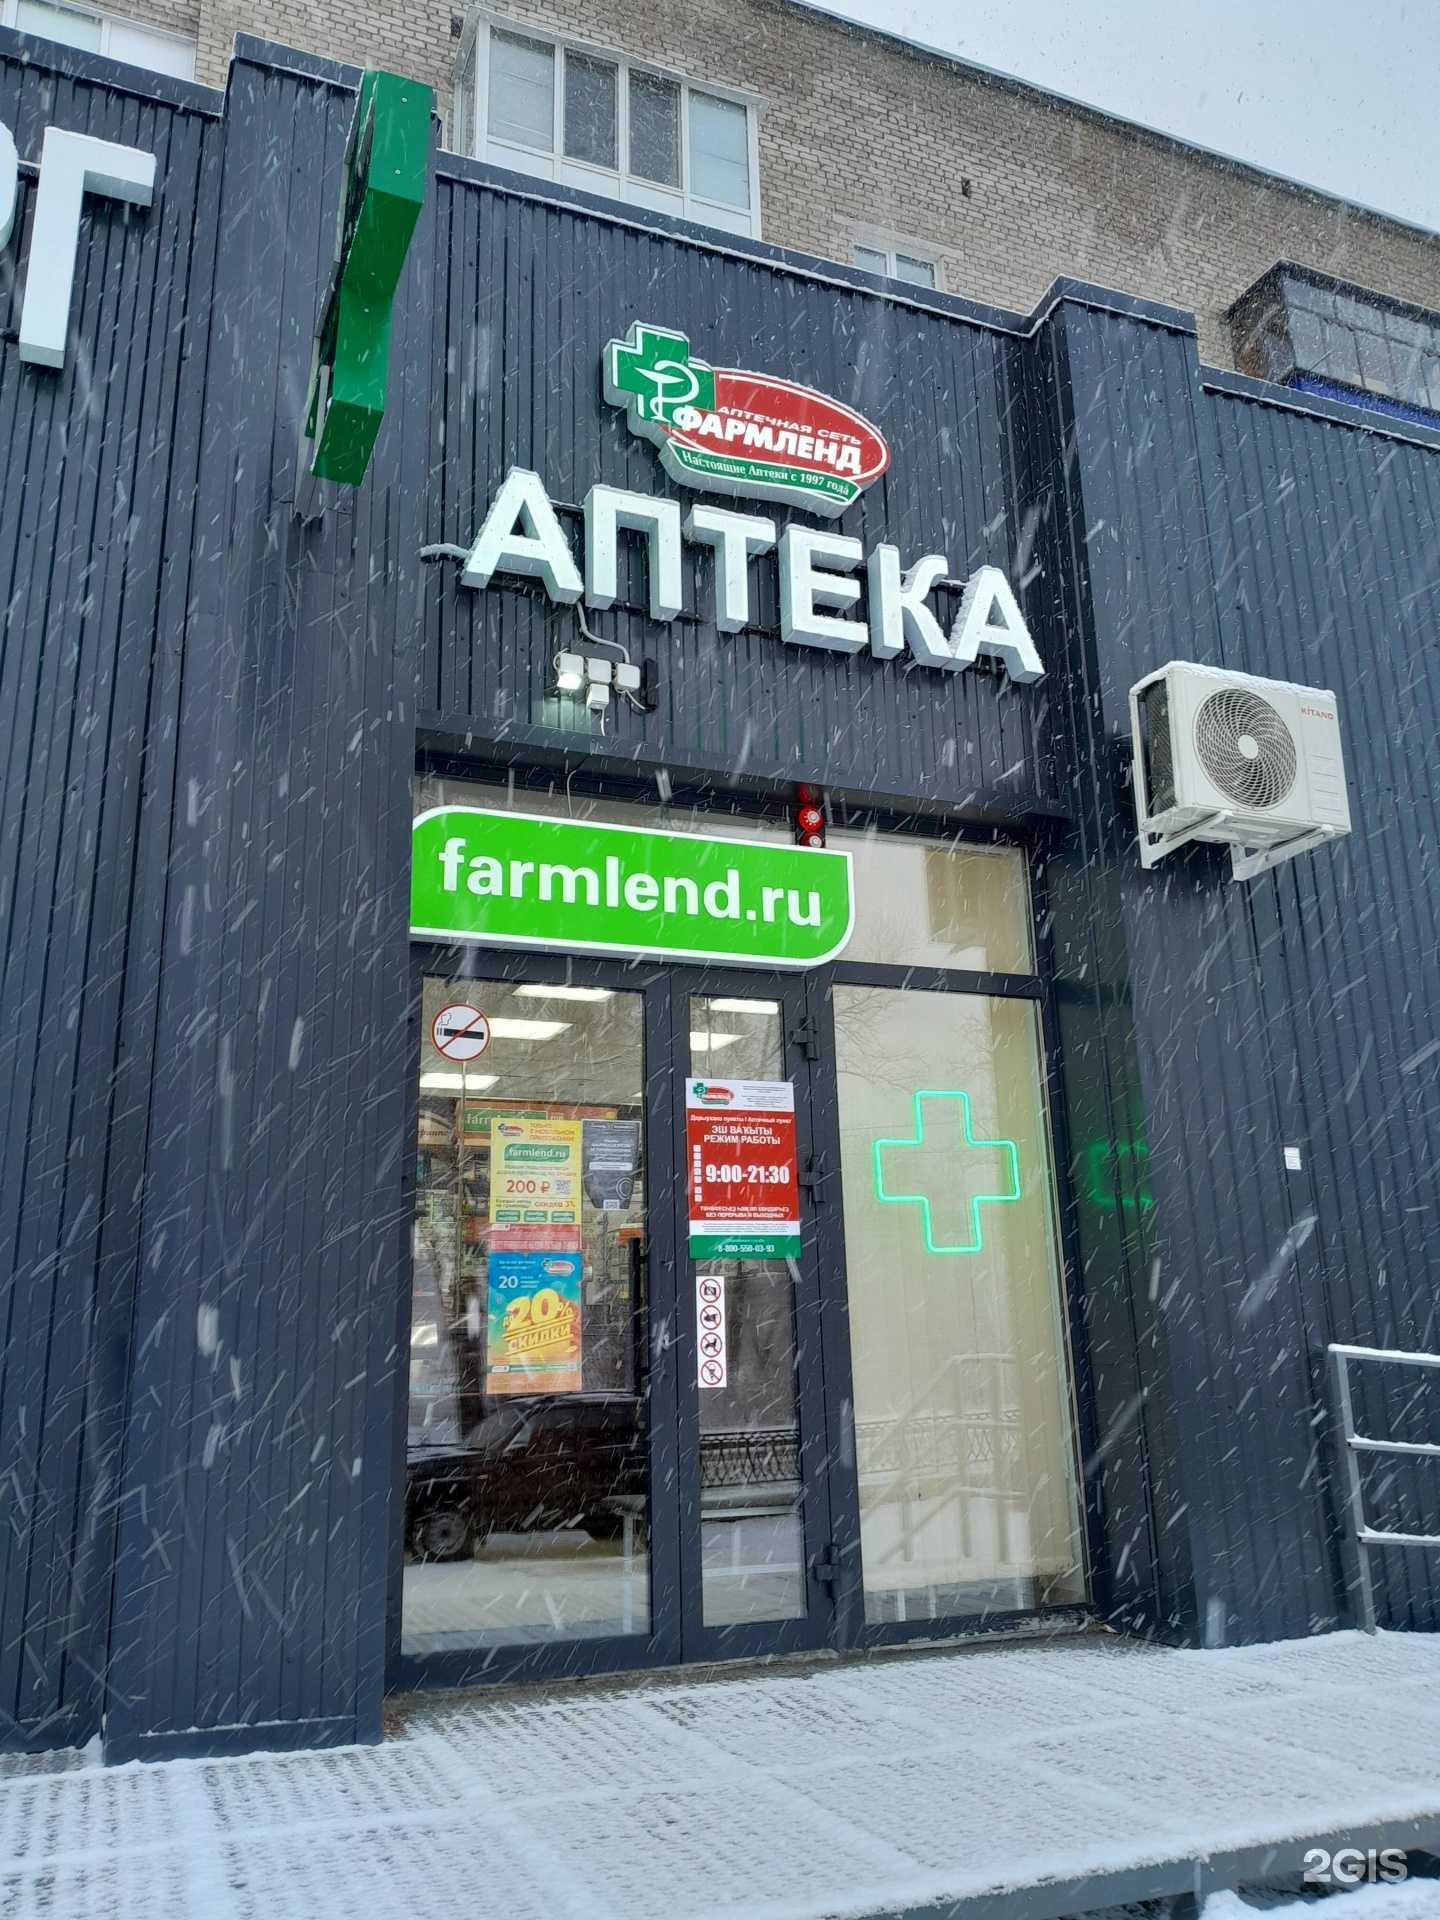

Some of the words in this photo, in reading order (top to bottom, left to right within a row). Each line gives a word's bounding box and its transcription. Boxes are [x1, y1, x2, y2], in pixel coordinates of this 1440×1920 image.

[0, 119, 156, 368] Г
[671, 404, 862, 475] ФАРМЛЕНД
[717, 406, 813, 434] АПТЕЧНАЯ
[816, 428, 863, 446] СЕТЬ
[748, 464, 789, 480] Аптеки
[791, 473, 797, 481] с
[800, 471, 825, 486] 1997
[826, 479, 851, 496] года
[461, 466, 1045, 684] АПТЕКА
[437, 838, 822, 927] farmlend.ru
[703, 1134, 738, 1144] РЕЖИМ
[740, 1135, 780, 1145] РАБОТЫ
[506, 1179, 536, 1194] 200
[705, 1164, 790, 1184] 9:00-21:30
[498, 1275, 519, 1289] 20
